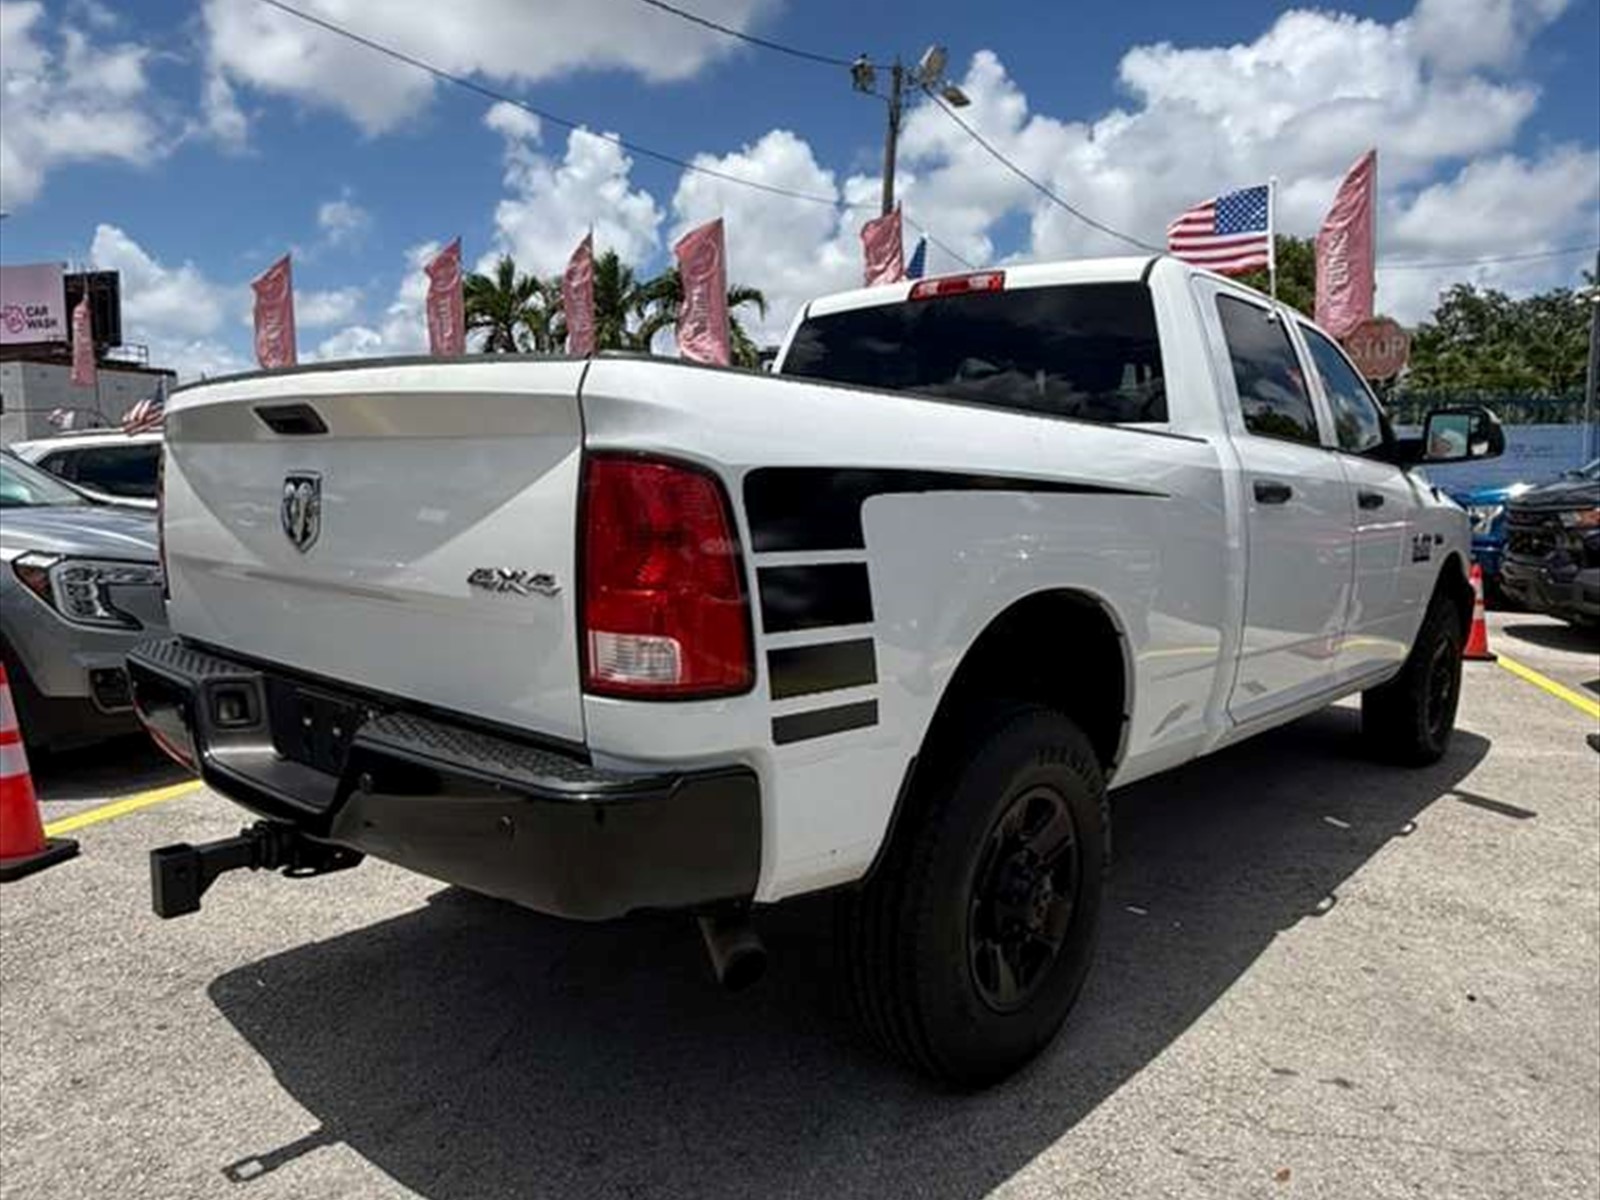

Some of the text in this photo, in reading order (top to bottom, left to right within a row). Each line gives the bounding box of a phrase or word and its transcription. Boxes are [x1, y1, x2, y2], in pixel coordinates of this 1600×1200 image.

[25, 305, 49, 318] CAR
[26, 318, 58, 330] WASH
[1349, 335, 1405, 361] STOP
